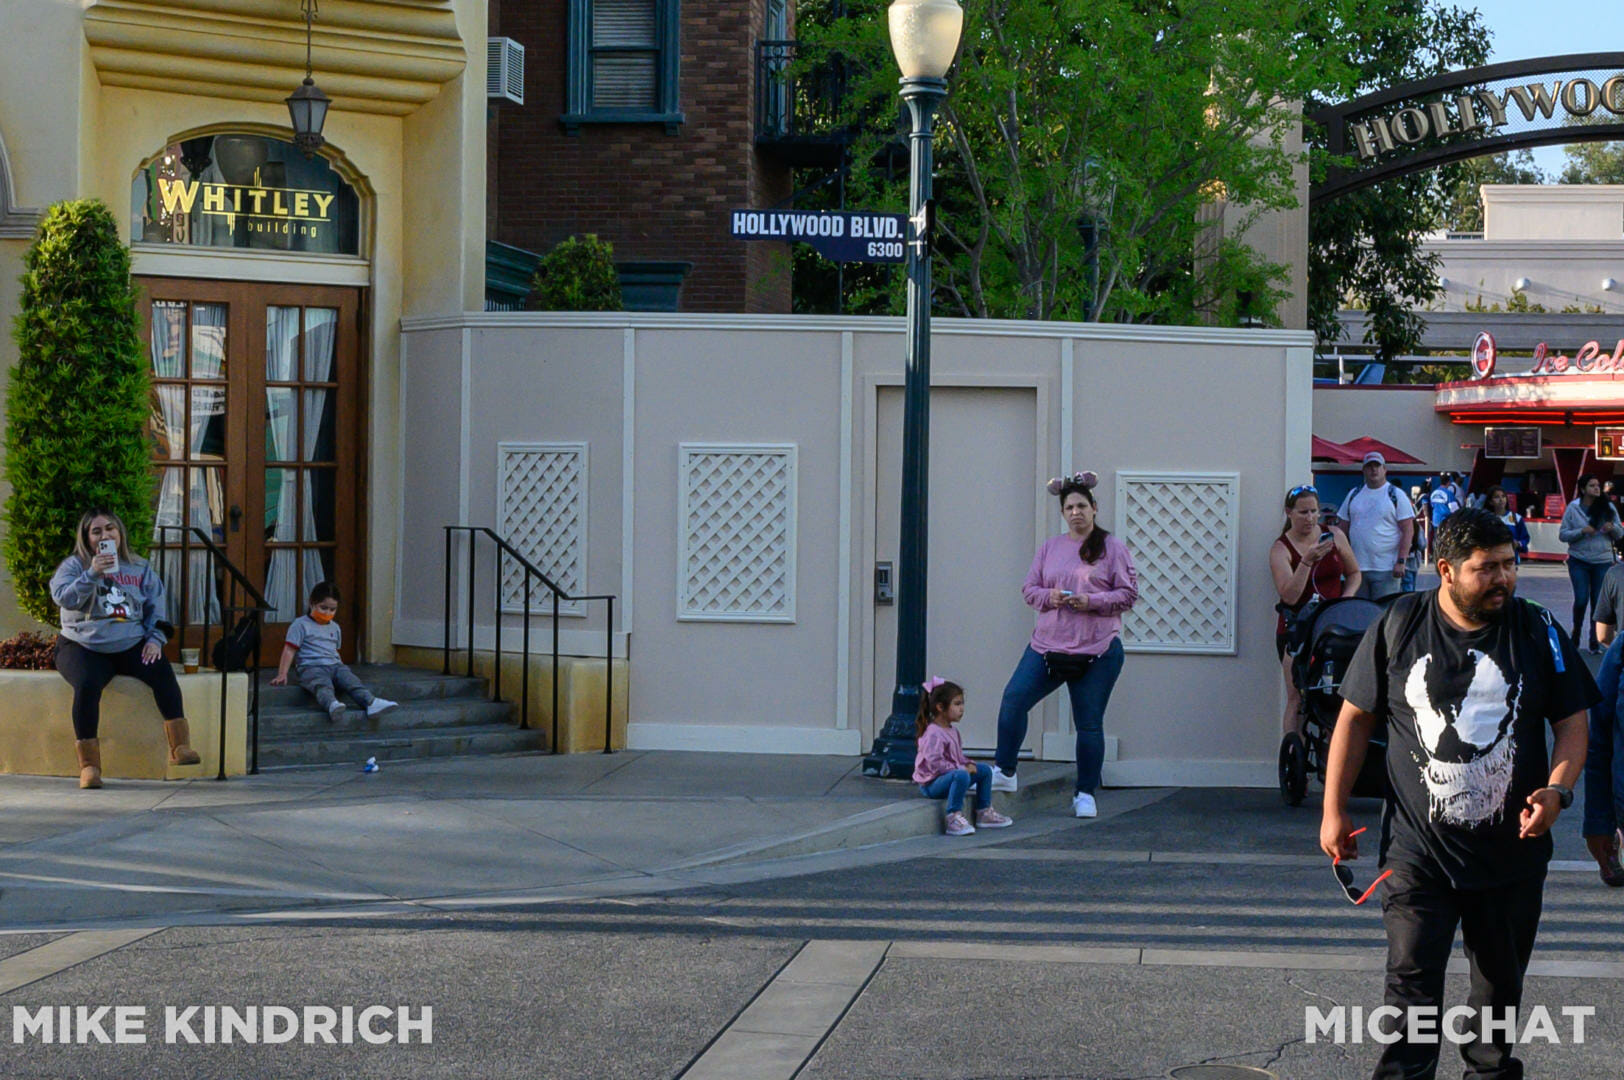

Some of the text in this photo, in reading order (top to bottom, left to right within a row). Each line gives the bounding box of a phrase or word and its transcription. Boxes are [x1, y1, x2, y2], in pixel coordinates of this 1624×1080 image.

[158, 178, 335, 218] WHITLEY
[248, 222, 317, 238] building
[733, 213, 904, 238] HOLLYWOOD BLVD.
[867, 242, 903, 257] 6300
[1531, 342, 1569, 373] Ice
